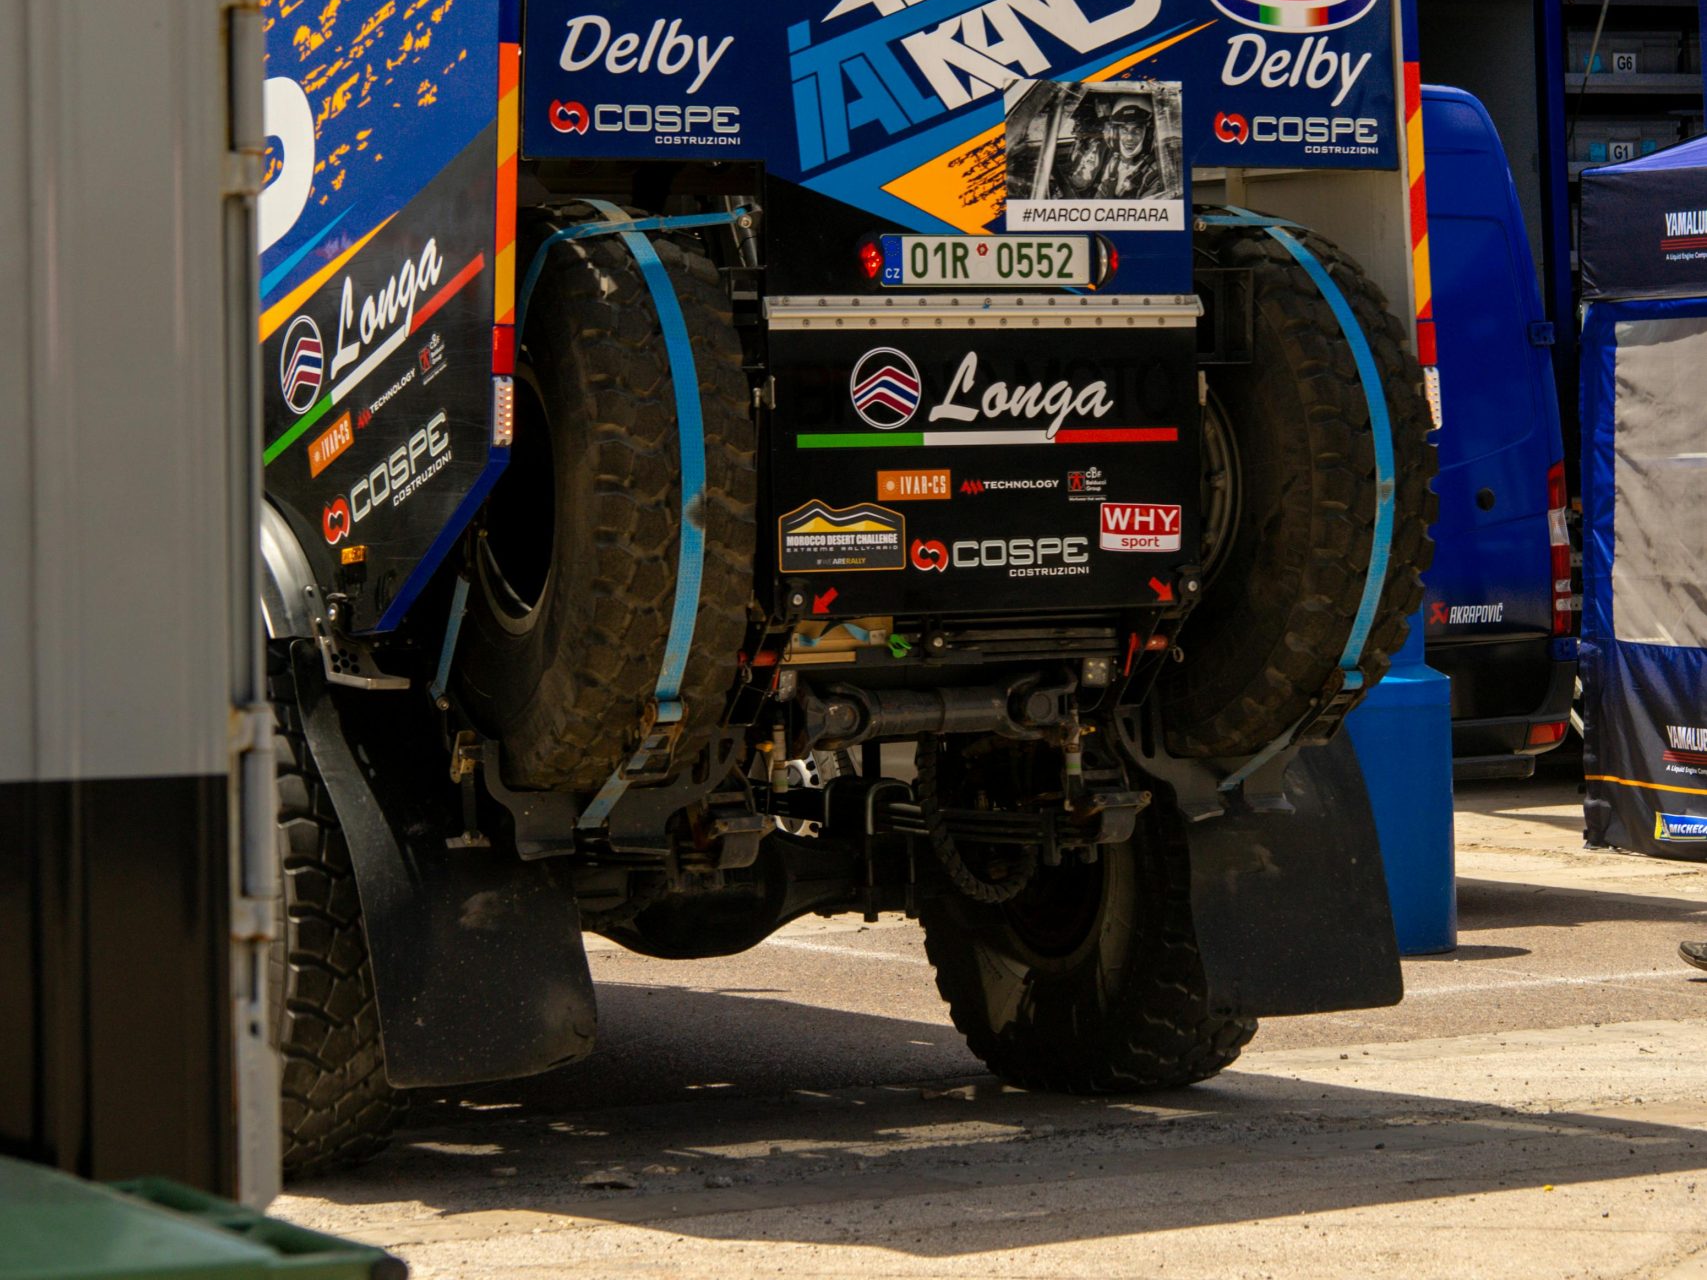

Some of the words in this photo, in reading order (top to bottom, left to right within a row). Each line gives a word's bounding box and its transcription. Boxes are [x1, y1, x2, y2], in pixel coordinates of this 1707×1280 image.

[559, 15, 734, 94] Delby
[1617, 56, 1633, 70] G6
[1221, 33, 1372, 107] Delby
[594, 103, 741, 134] COSPE
[1252, 115, 1379, 144] COSPE
[654, 135, 741, 145] COSTRUZIONI
[1304, 145, 1379, 154] COSTRUZIONI
[1614, 146, 1629, 160] G1
[1022, 208, 1091, 222] #MARCO
[1094, 208, 1169, 222] CARRARA
[885, 268, 900, 278] CZ
[911, 242, 970, 278] 01R
[997, 242, 1074, 278] 0552
[331, 237, 444, 380] Longa
[370, 368, 416, 414] TECHNOLOGY
[928, 351, 1114, 439] Longa
[351, 412, 449, 523] COSPE
[393, 450, 452, 507] COSTRUZIONI
[983, 480, 1059, 489] TECHNOLOGY
[1103, 507, 1178, 532] WHY
[786, 536, 826, 546] MOROCCO
[827, 535, 855, 545] DESERT
[856, 533, 898, 544] CHALLENGE
[953, 537, 1089, 567] COSPE
[1121, 536, 1160, 548] sport
[1009, 567, 1089, 577] COSTRUZIONI
